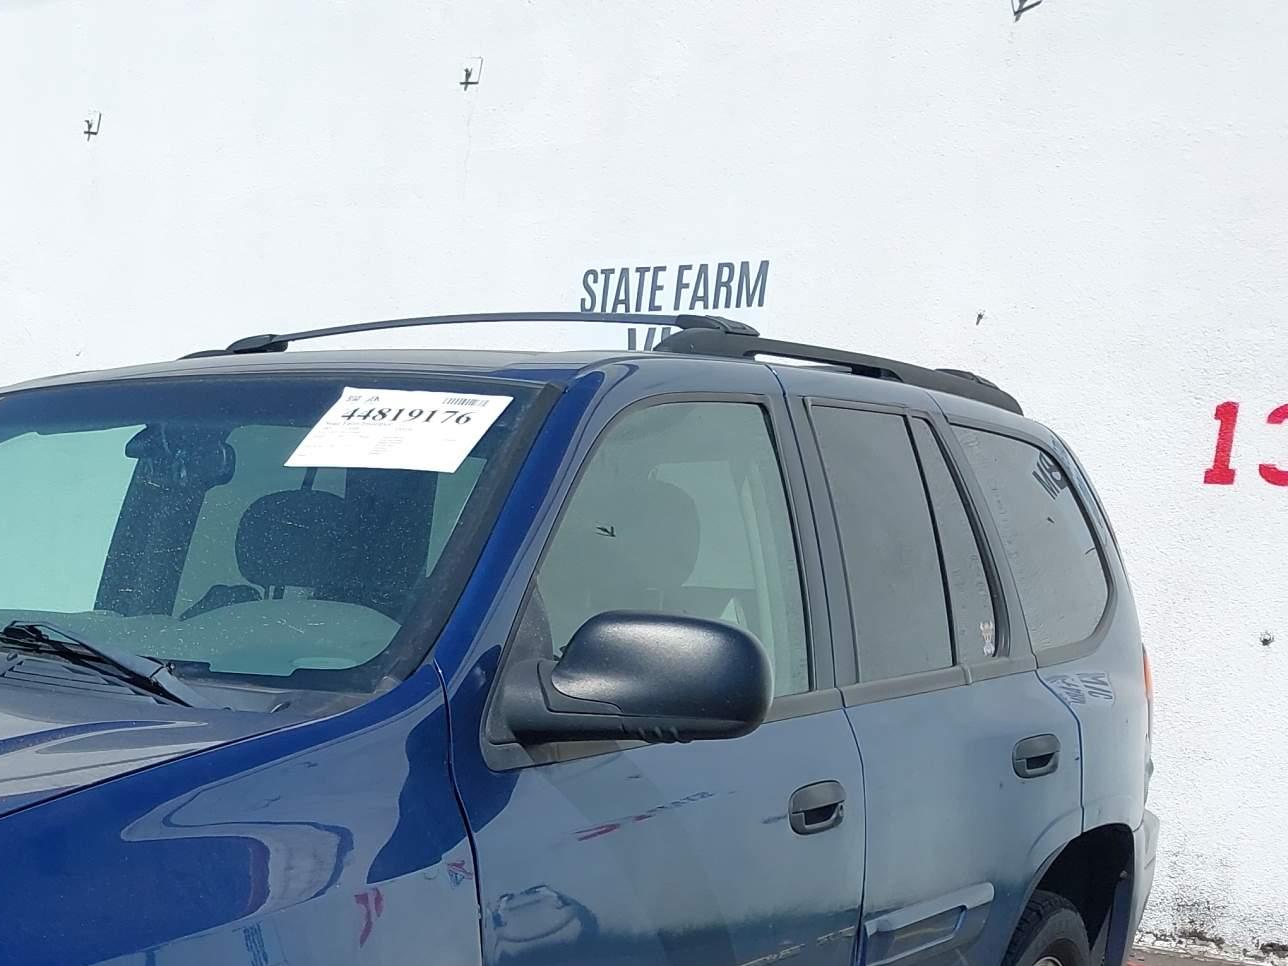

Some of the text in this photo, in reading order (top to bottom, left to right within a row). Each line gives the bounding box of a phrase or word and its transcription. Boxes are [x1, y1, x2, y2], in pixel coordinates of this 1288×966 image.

[580, 260, 769, 313] STATE FARM
[341, 407, 478, 425] 44819176
